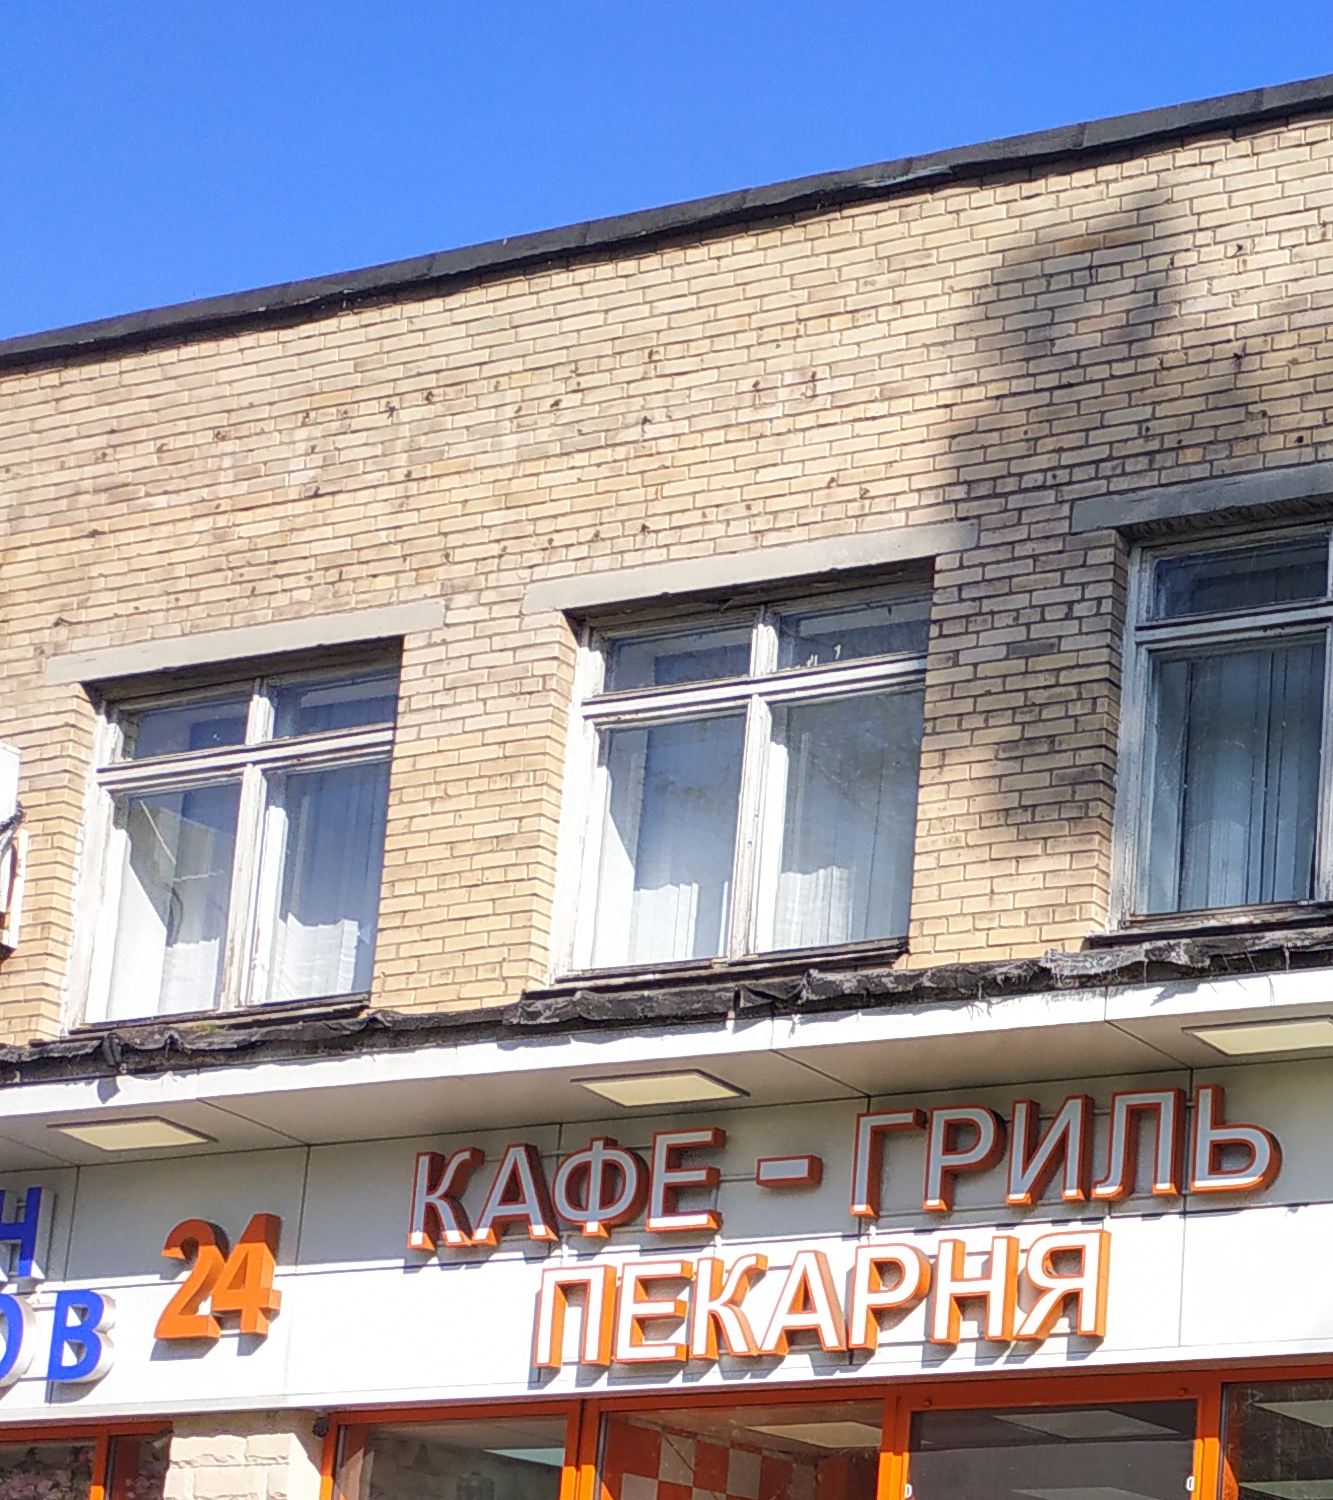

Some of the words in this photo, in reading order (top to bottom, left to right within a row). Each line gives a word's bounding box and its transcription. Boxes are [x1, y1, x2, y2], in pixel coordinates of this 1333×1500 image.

[407, 1127, 726, 1251] КАФЕ
[850, 1084, 1282, 1218] ГРИЛЬ
[154, 1213, 281, 1340] 24
[533, 1229, 1111, 1369] ПЕКАРНЯ
